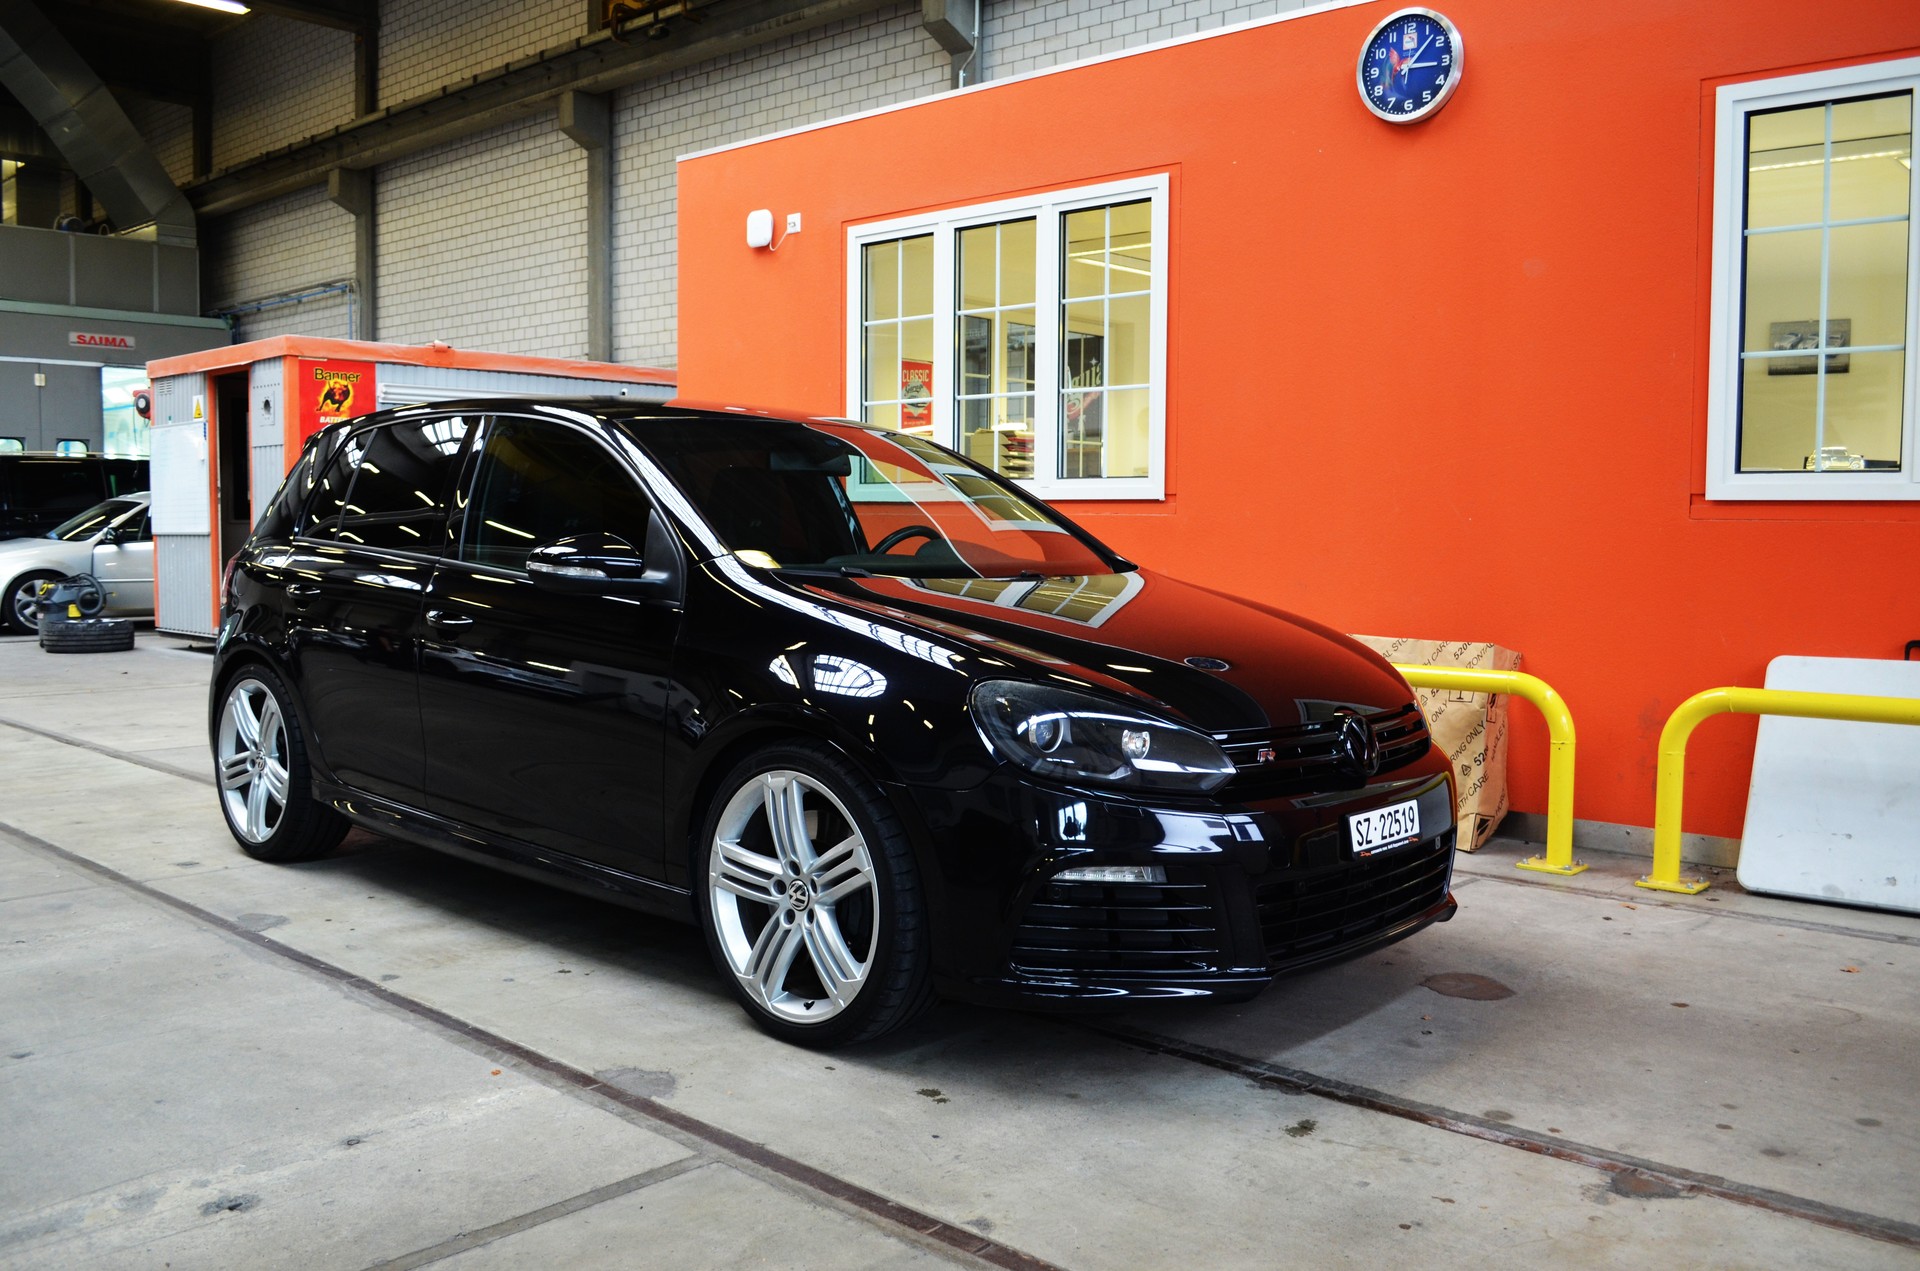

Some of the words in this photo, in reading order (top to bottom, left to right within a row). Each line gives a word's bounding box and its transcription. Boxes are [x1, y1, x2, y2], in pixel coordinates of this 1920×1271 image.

[1404, 22, 1416, 34] 12
[1425, 24, 1430, 35] 1
[1389, 32, 1397, 43] 11
[1435, 36, 1444, 47] 2
[1375, 48, 1387, 59] 10
[1441, 55, 1450, 66] 3
[1370, 67, 1379, 78] 9
[1435, 75, 1445, 85] 4
[1374, 85, 1383, 96] 8
[1422, 91, 1431, 102] 5
[1387, 98, 1396, 109] 7
[1404, 99, 1413, 110] 6
[76, 334, 128, 348] SAIMA
[314, 368, 361, 382] Banner
[902, 369, 930, 382] CLASSIC
[1431, 700, 1448, 723] ONLY
[1465, 720, 1486, 747] ONLY
[1467, 771, 1490, 797] CARE
